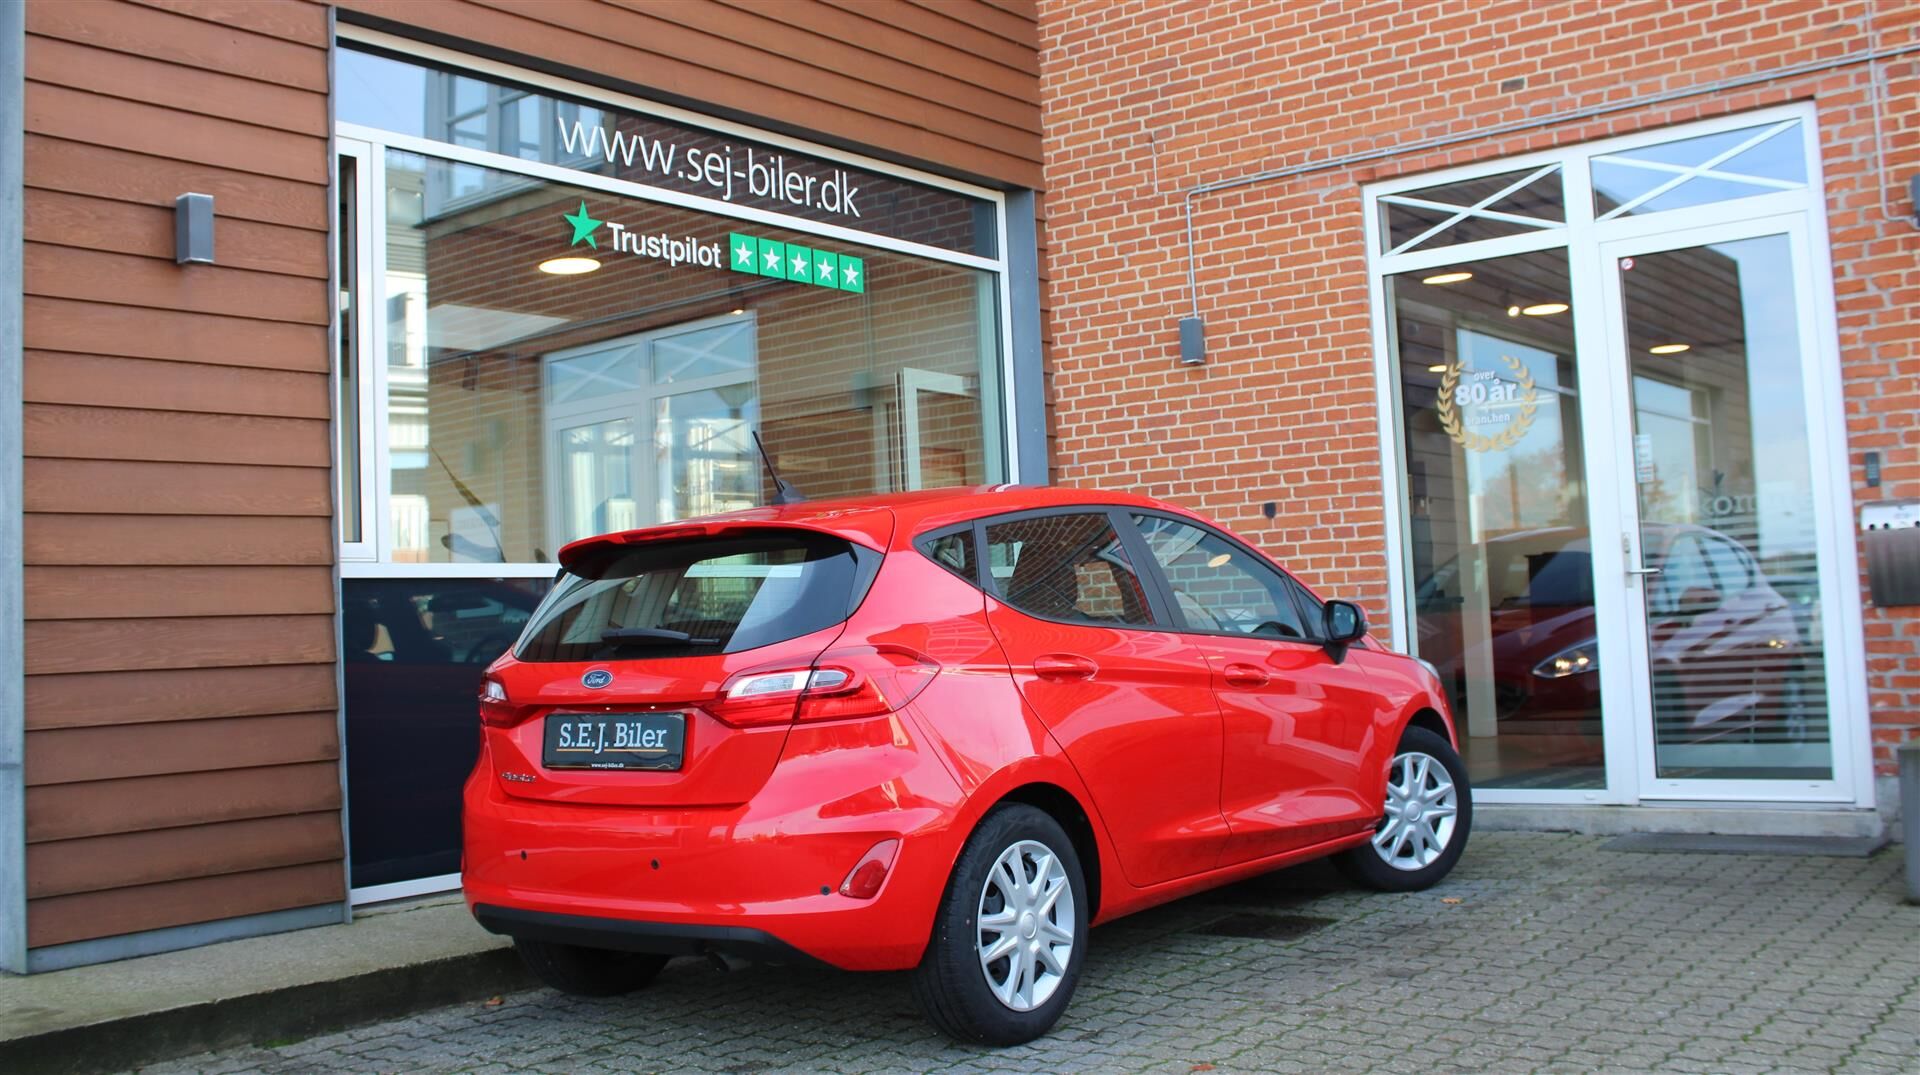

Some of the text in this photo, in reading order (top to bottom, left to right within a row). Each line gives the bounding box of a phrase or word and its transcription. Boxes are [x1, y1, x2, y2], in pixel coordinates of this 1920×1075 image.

[558, 116, 861, 218] www.sej-biler.dk
[606, 222, 723, 269] Trustpilot
[1473, 370, 1496, 381] over
[1455, 378, 1517, 406] 80 år
[587, 672, 606, 685] Ford
[559, 722, 668, 754] S.E.J. Biler
